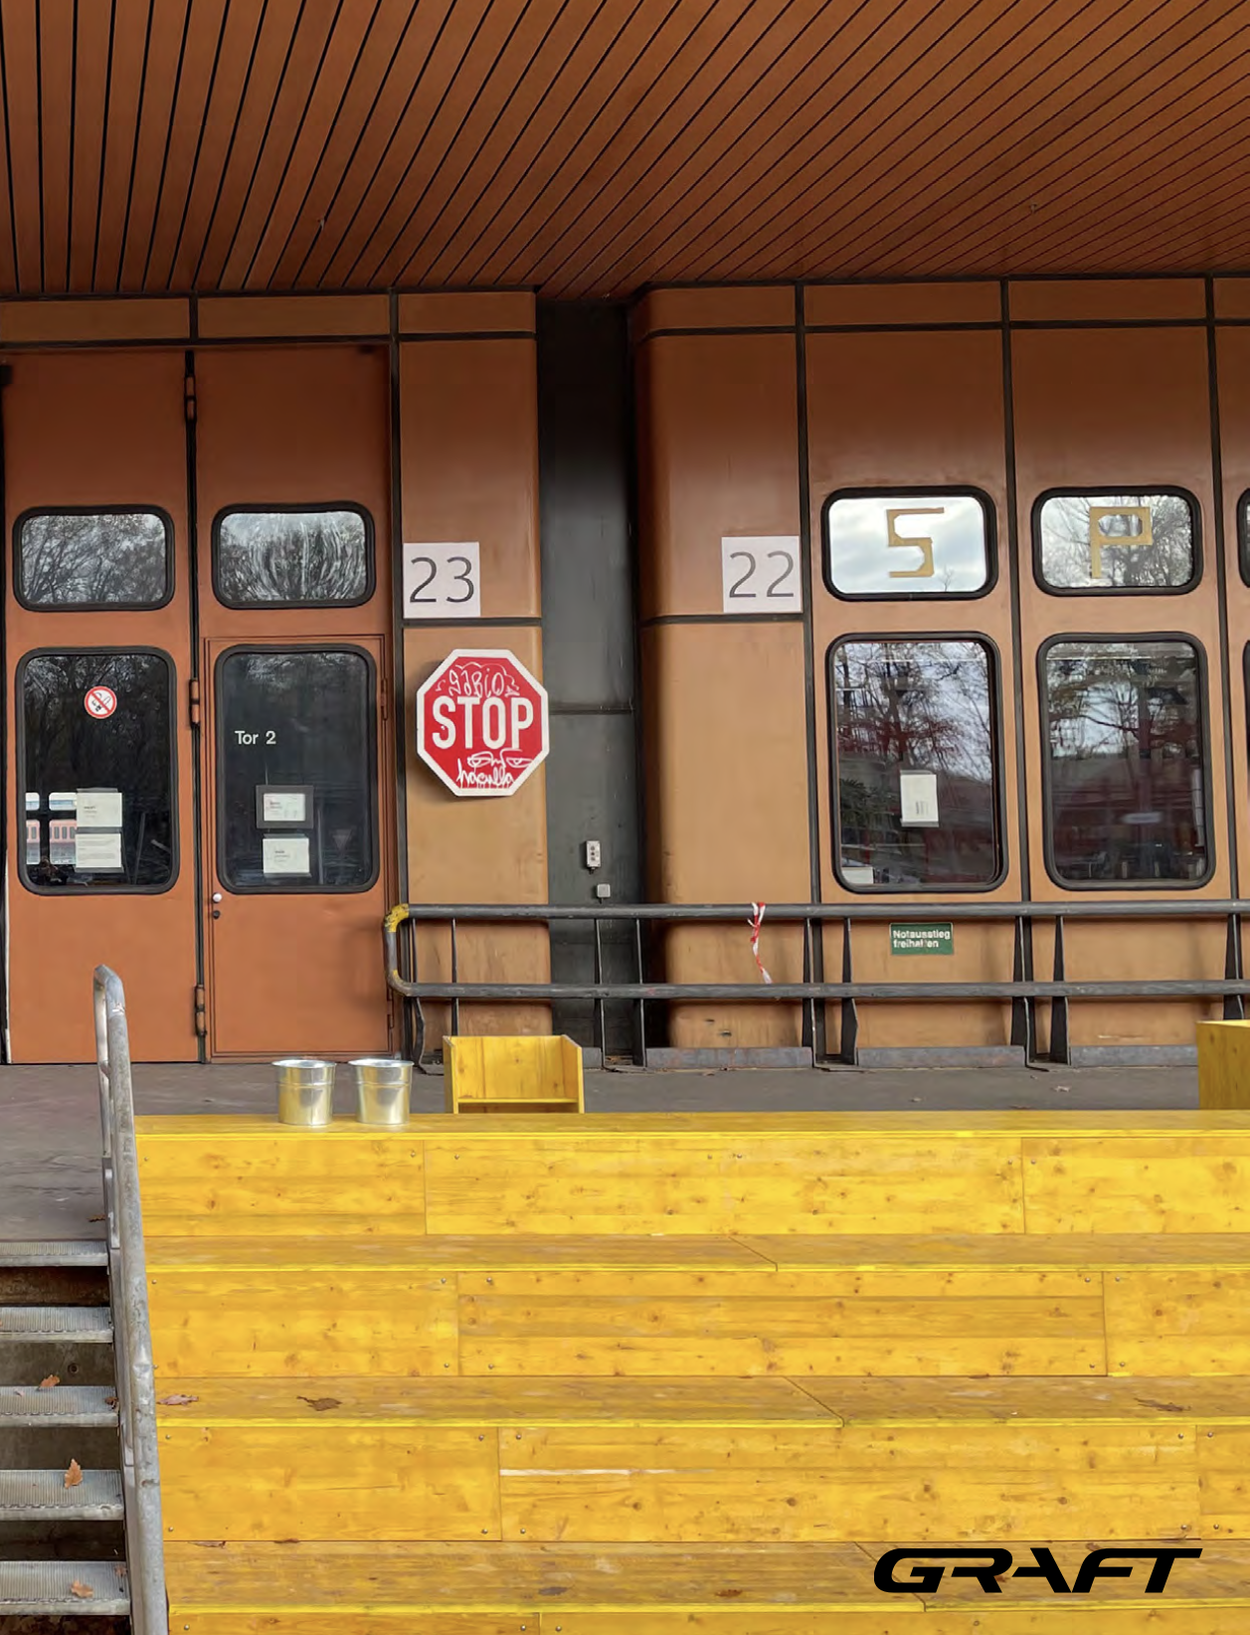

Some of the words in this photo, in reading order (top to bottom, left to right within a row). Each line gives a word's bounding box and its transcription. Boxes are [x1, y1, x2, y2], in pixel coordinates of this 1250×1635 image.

[886, 507, 944, 578] S
[1089, 506, 1152, 578] P
[410, 556, 474, 603] 23
[729, 551, 795, 598] 22
[234, 730, 259, 745] Tor
[265, 730, 277, 745] 2
[432, 695, 534, 750] STOP
[892, 930, 951, 940] Notausstieg
[893, 938, 939, 948] freihalen
